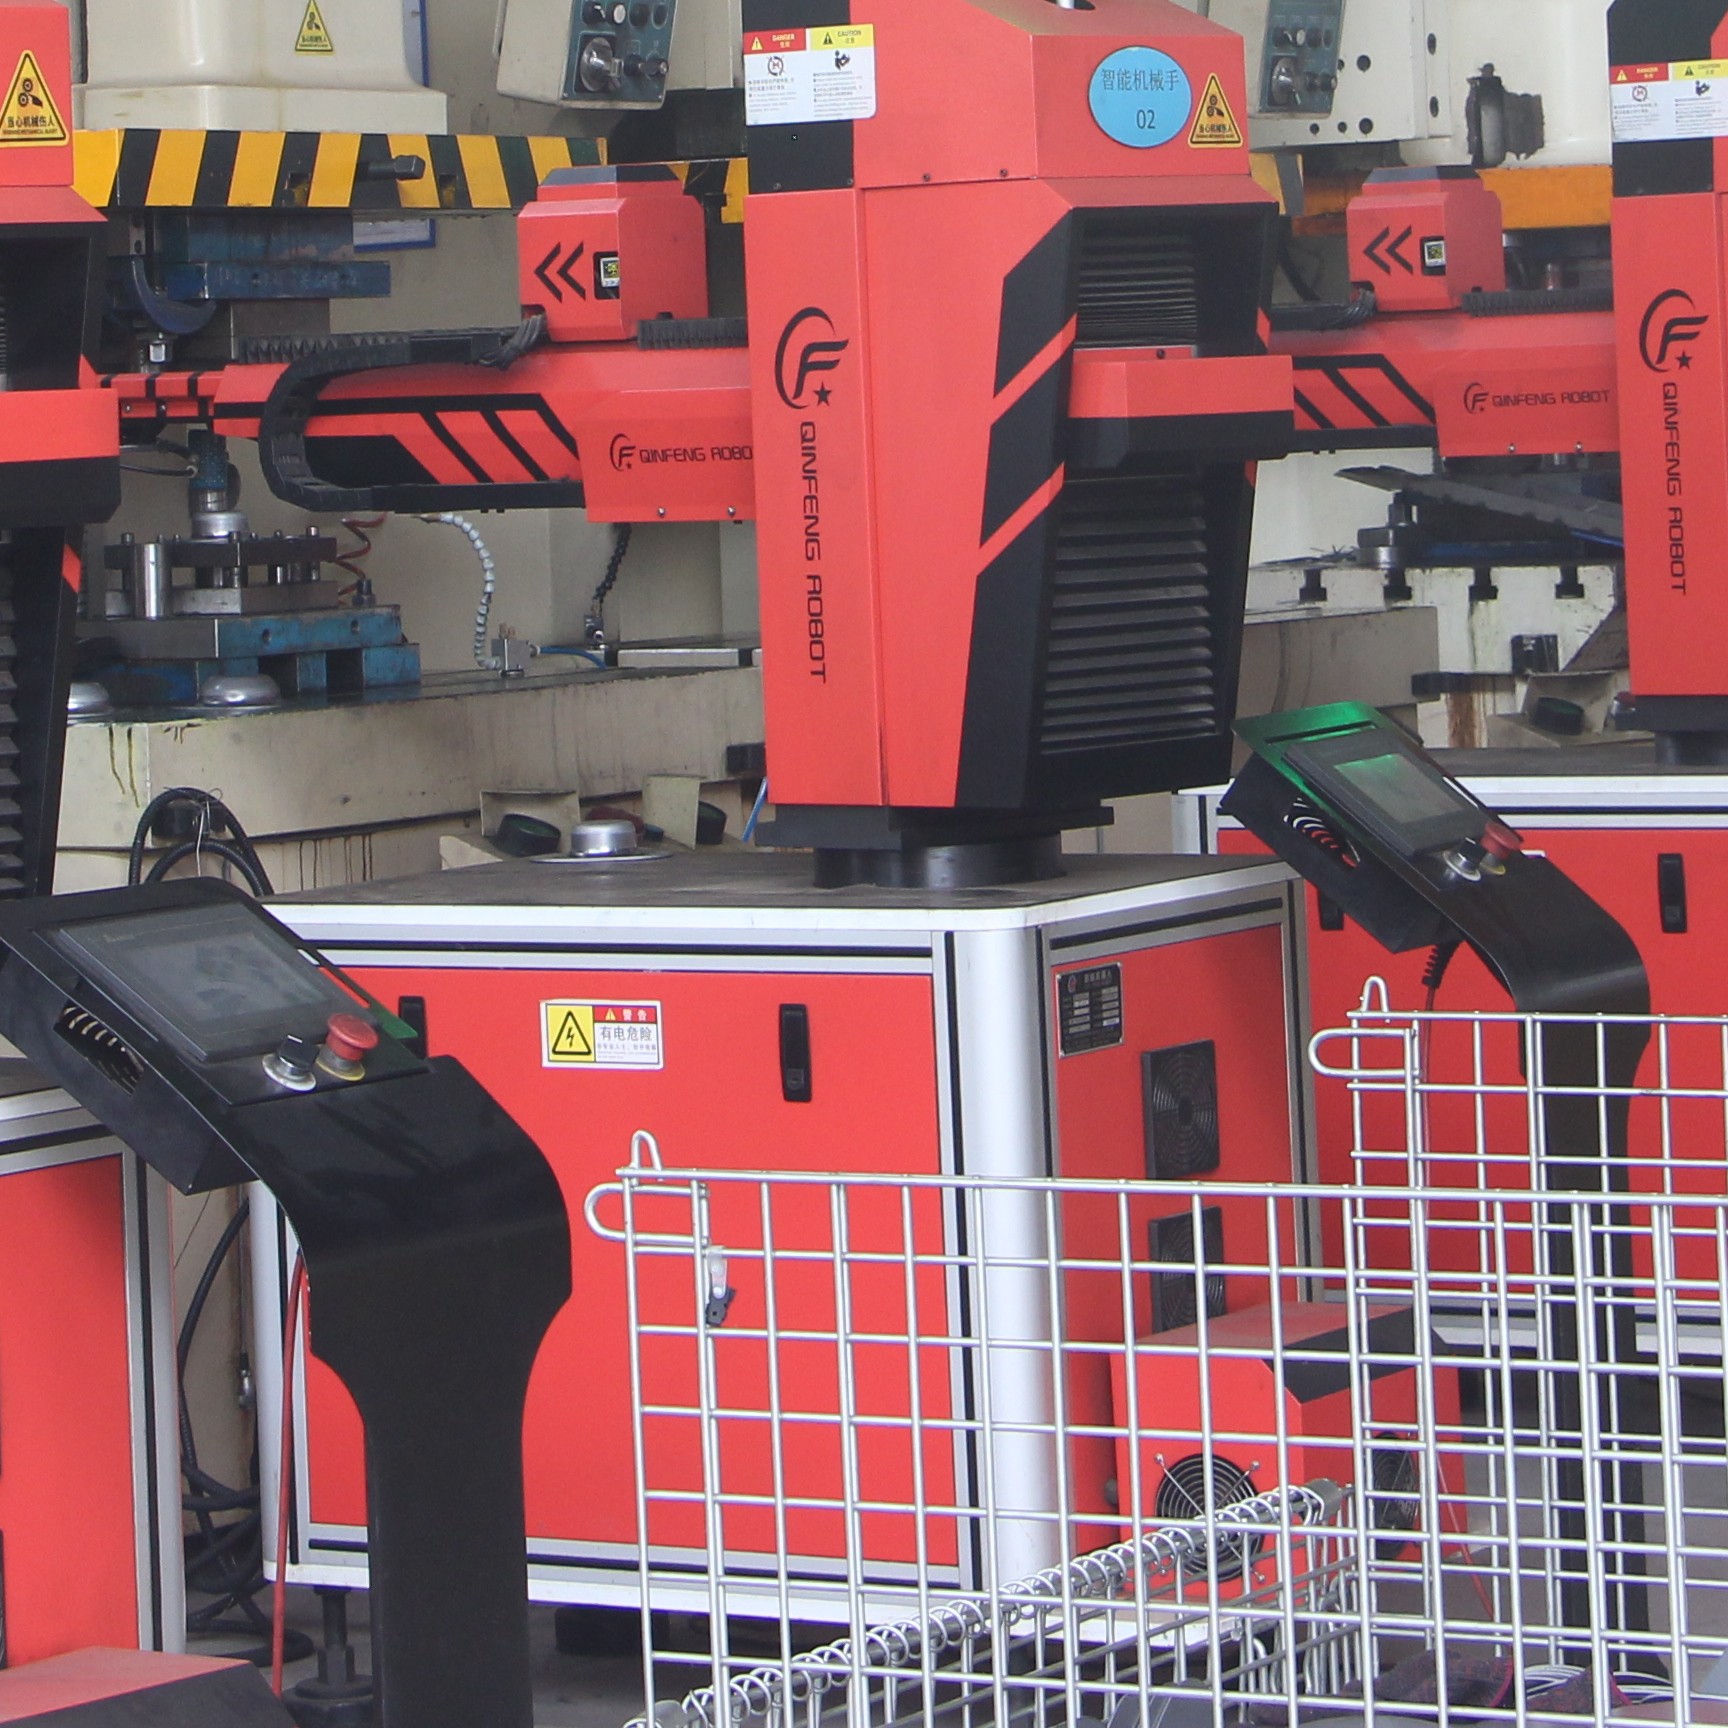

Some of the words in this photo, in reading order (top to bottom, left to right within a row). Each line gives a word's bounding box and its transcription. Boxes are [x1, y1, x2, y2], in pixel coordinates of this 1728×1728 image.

[1101, 68, 1180, 92] 智能机械手
[7, 114, 56, 129] 当心机械伤人
[1136, 109, 1157, 130] 02
[1492, 392, 1556, 408] QINFENG
[1560, 390, 1610, 405] ROBOT
[1661, 381, 1683, 498] QINFENG
[639, 446, 706, 464] QINFENG
[799, 421, 822, 562] QINFENG
[1667, 507, 1687, 597] ROBOT
[805, 573, 827, 684] ROBOT
[622, 1008, 648, 1022] 警告
[600, 1025, 653, 1042] 有电危险
